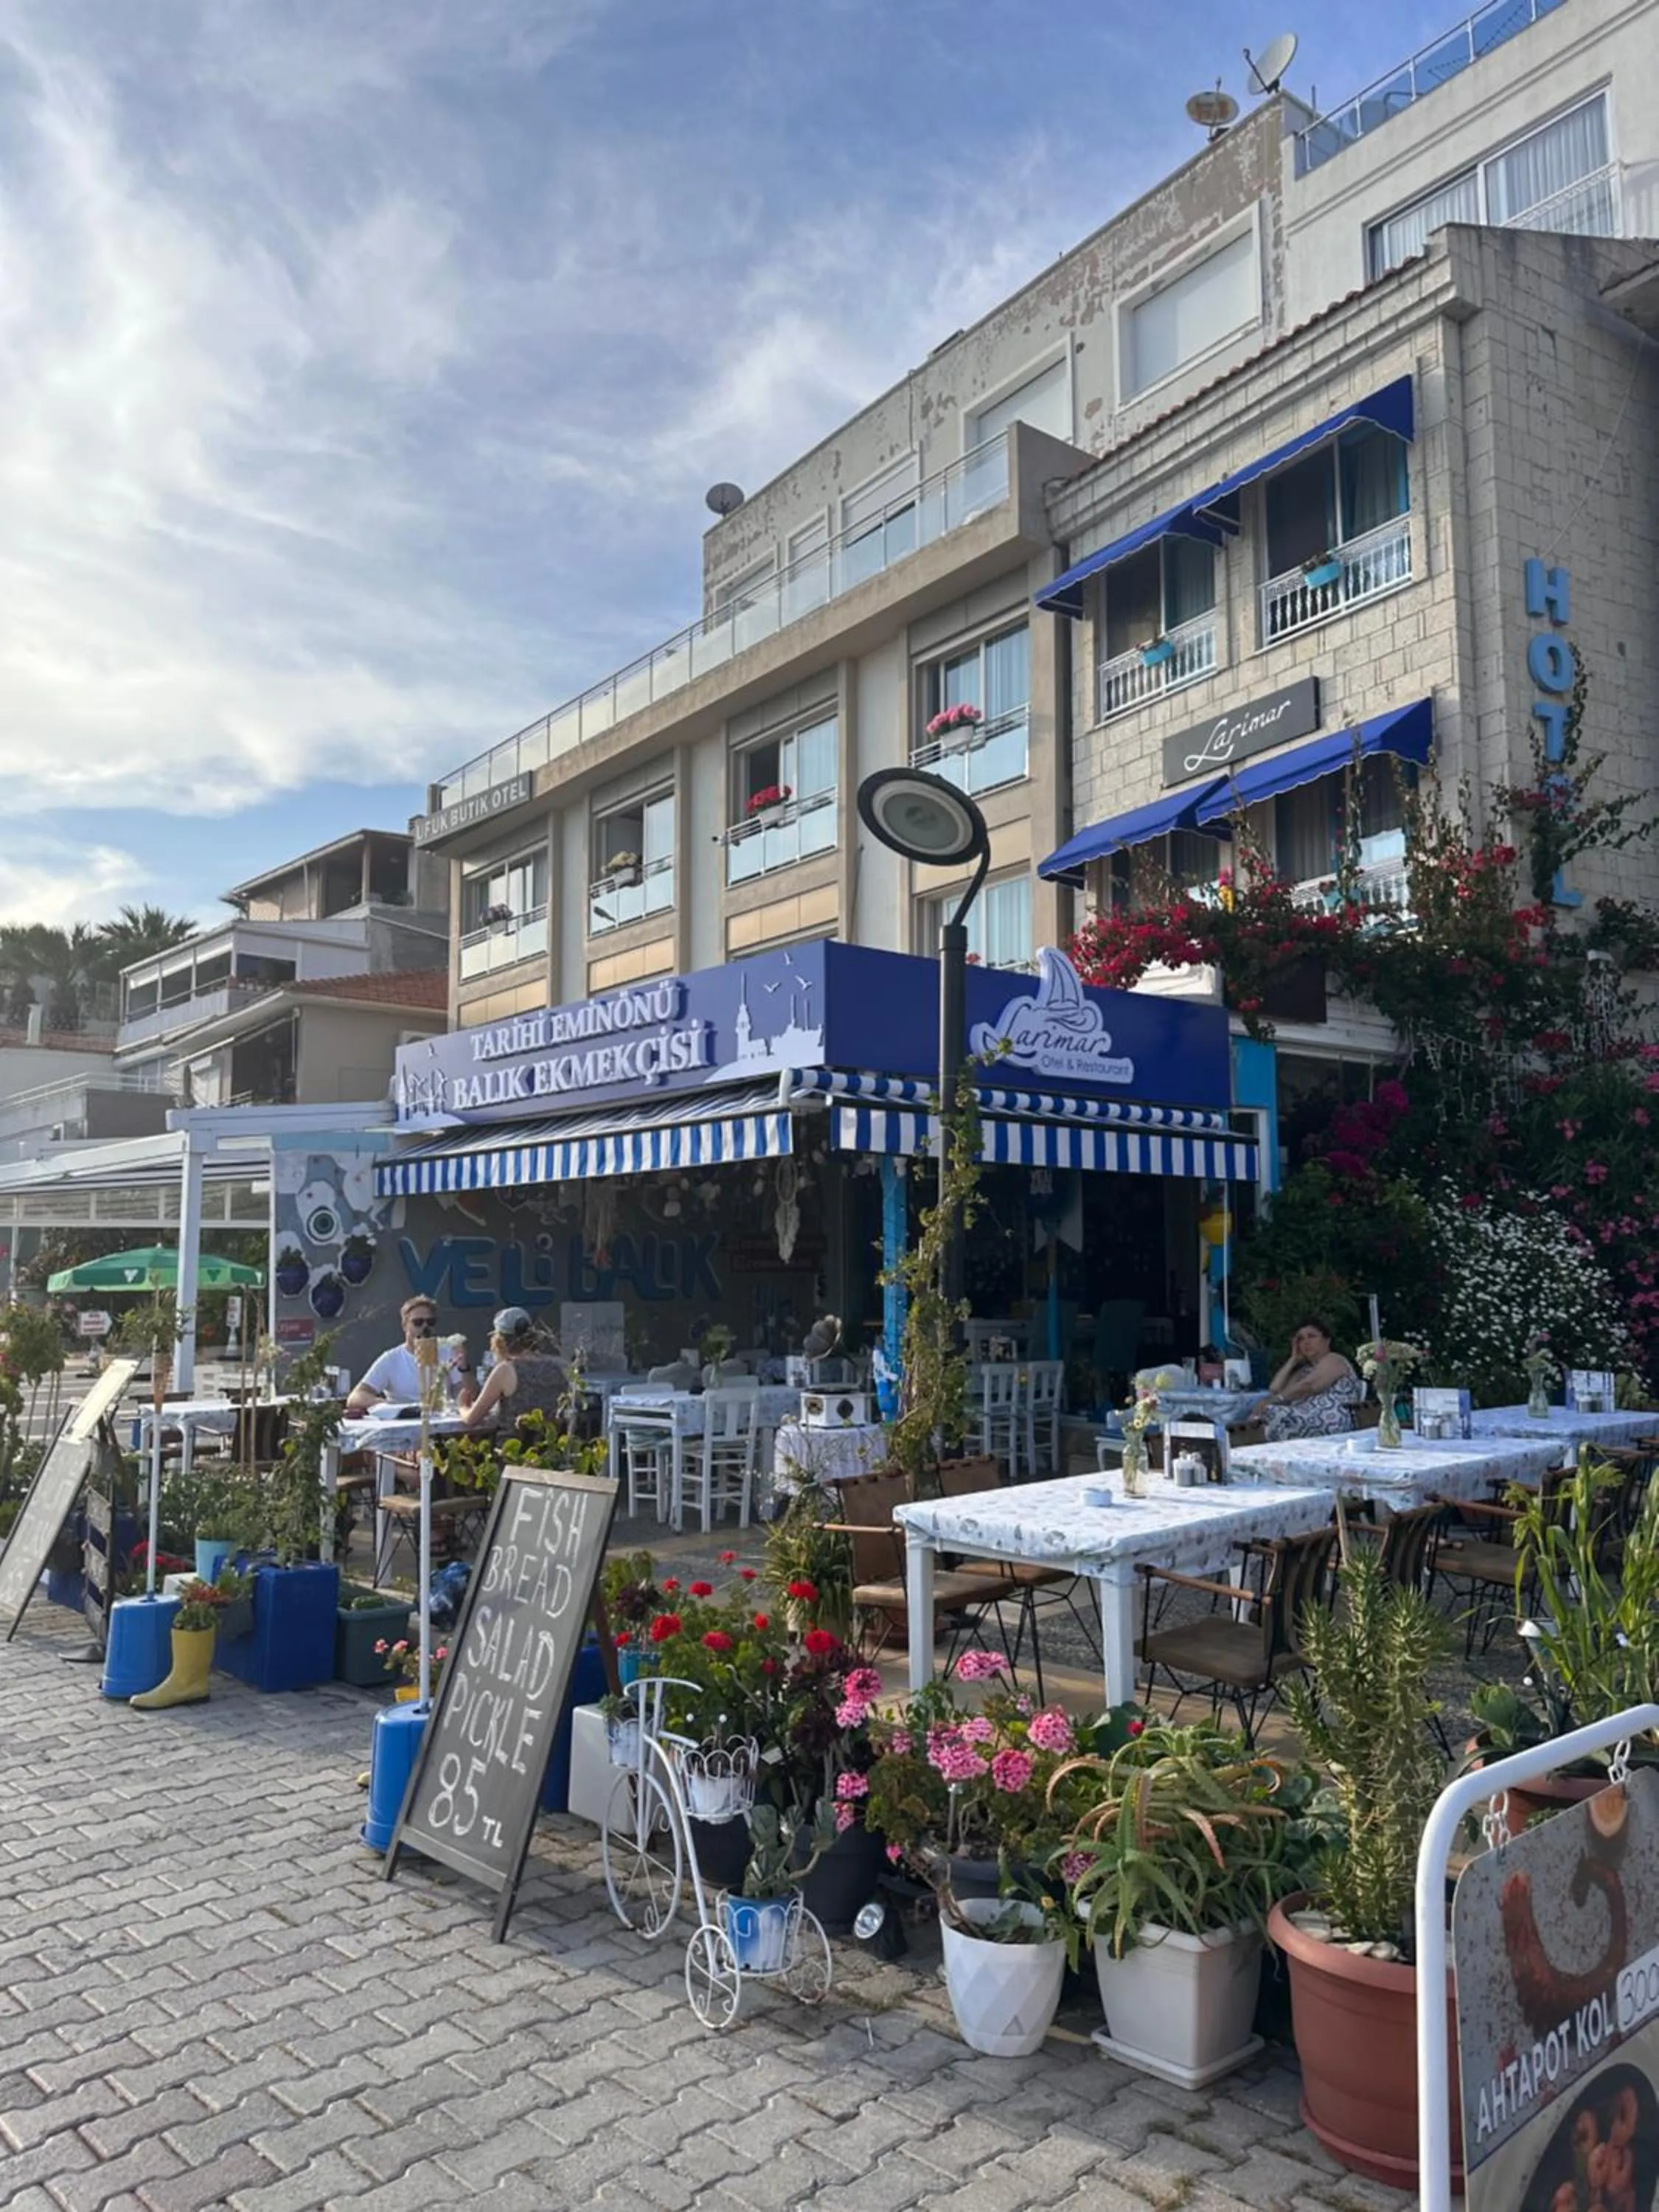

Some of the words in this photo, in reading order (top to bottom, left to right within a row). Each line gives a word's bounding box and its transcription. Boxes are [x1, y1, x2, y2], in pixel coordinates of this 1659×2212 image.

[1183, 700, 1291, 771] Larimar
[417, 812, 448, 841] UFUK
[492, 778, 526, 808] OTEL
[470, 1010, 546, 1062] TARİHİ
[551, 981, 675, 1040] EMİNÖNÜ
[983, 1003, 1107, 1059] Larimar
[452, 1064, 529, 1109] BALIK
[532, 1019, 709, 1086] EKMEKÇİSİ
[1077, 1059, 1129, 1077] Restaurant
[481, 1544, 573, 1619] BREAD
[467, 1604, 556, 1701] SALAD
[427, 1752, 487, 1836] 85
[481, 1815, 504, 1848] TL
[1476, 2019, 1571, 2143] AHTAPOT
[1575, 1991, 1615, 2058] KOL
